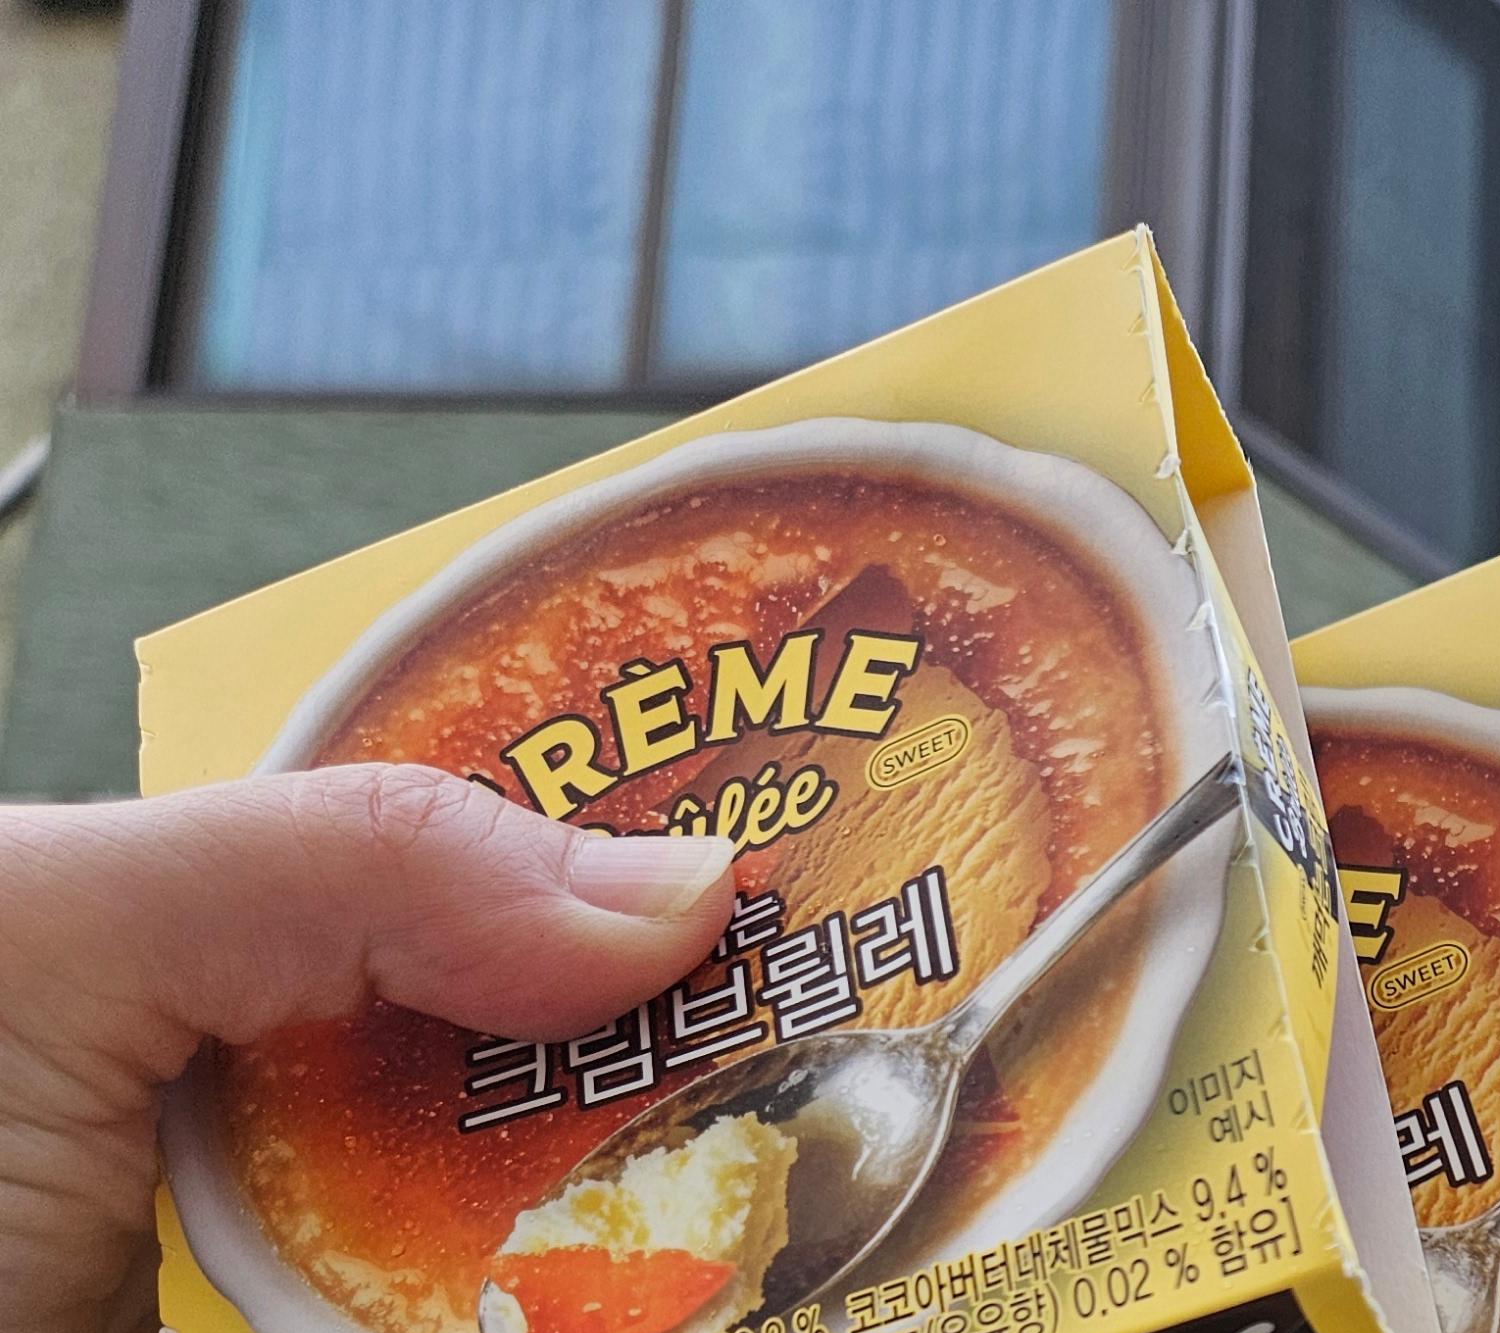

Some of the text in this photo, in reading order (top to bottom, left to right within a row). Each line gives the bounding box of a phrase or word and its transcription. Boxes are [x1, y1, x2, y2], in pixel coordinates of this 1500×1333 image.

[475, 628, 924, 822] RÈME
[883, 728, 957, 777] SWEET
[460, 866, 957, 1130] 크림브륄레
[1384, 953, 1457, 999] SWEET
[1168, 1048, 1267, 1116] 이미지
[1209, 1089, 1276, 1144] 예시
[1191, 1162, 1247, 1224] 9.4
[1254, 1145, 1288, 1198] %
[1073, 1257, 1154, 1319] 0.02
[1165, 1241, 1200, 1290] %
[1209, 1195, 1304, 1279] 함유]
